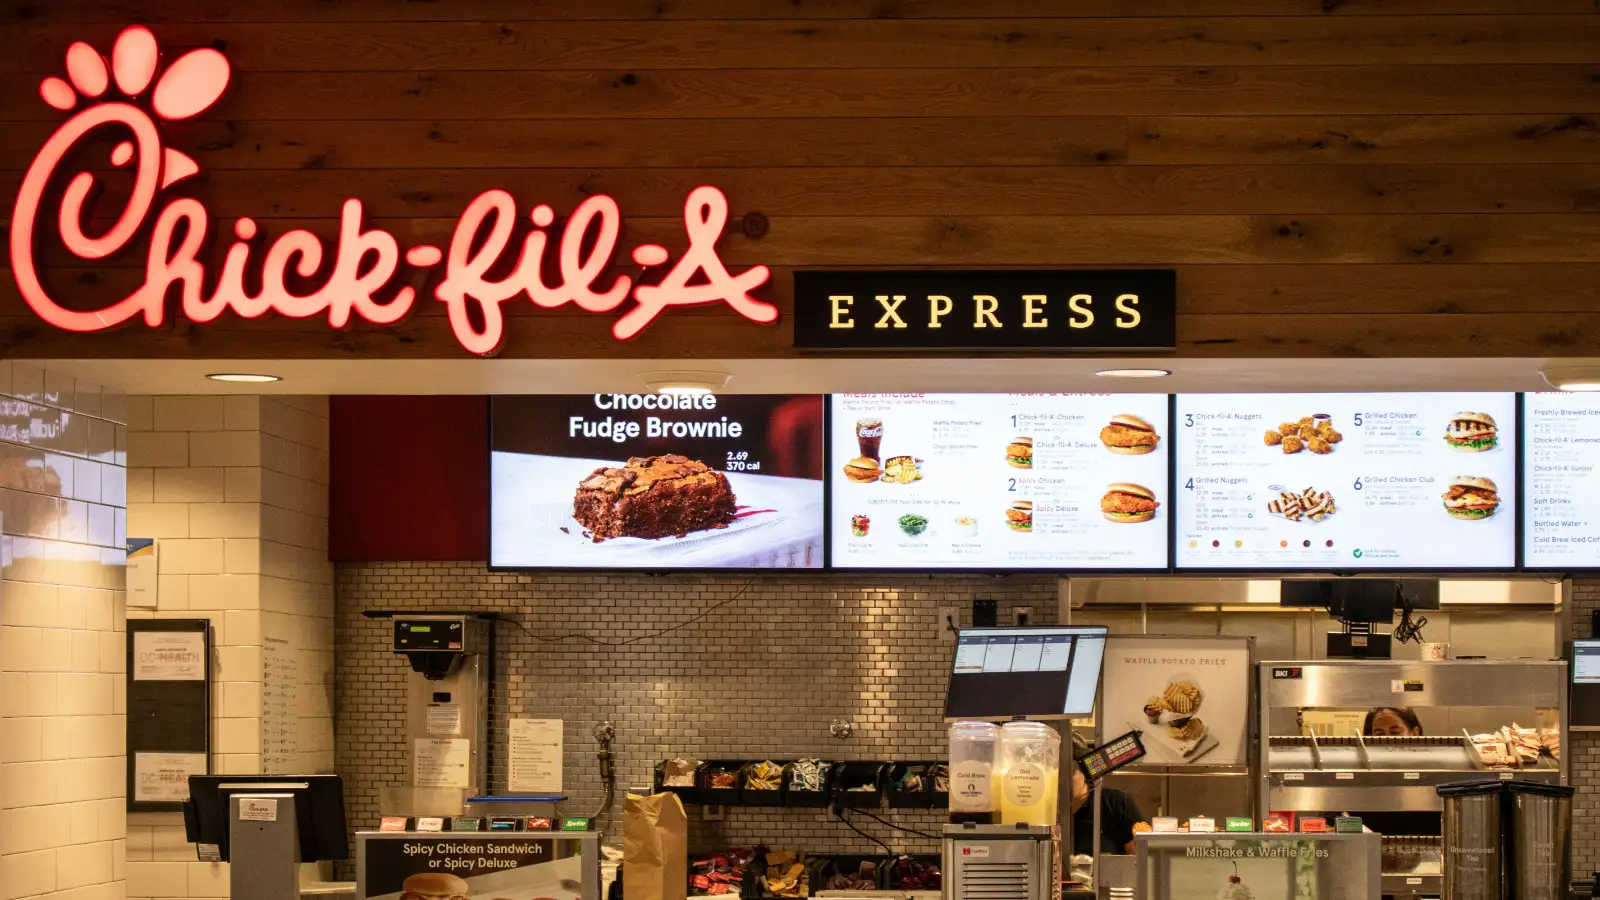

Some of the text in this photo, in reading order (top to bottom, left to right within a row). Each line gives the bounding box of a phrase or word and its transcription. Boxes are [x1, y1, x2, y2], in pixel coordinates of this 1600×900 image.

[11, 98, 778, 354] Chick-fil-A
[828, 294, 1142, 329] EXPRESS
[595, 393, 717, 410] Chocolate
[1010, 414, 1017, 428] 1
[1185, 413, 1194, 427] 3
[1353, 413, 1363, 426] 5
[569, 415, 743, 442] Fudge Brownie
[726, 451, 748, 461] 2.69
[726, 461, 760, 471] 370 cal
[1008, 477, 1016, 491] 2
[1185, 477, 1194, 491] 4
[1353, 477, 1363, 490] 6
[566, 820, 587, 828] Sprite
[403, 843, 542, 856] Spicy Chicken Sandwich
[1186, 846, 1329, 858] Milkshake & Waffle Fries
[428, 857, 518, 870] or Spicy Deluxe
